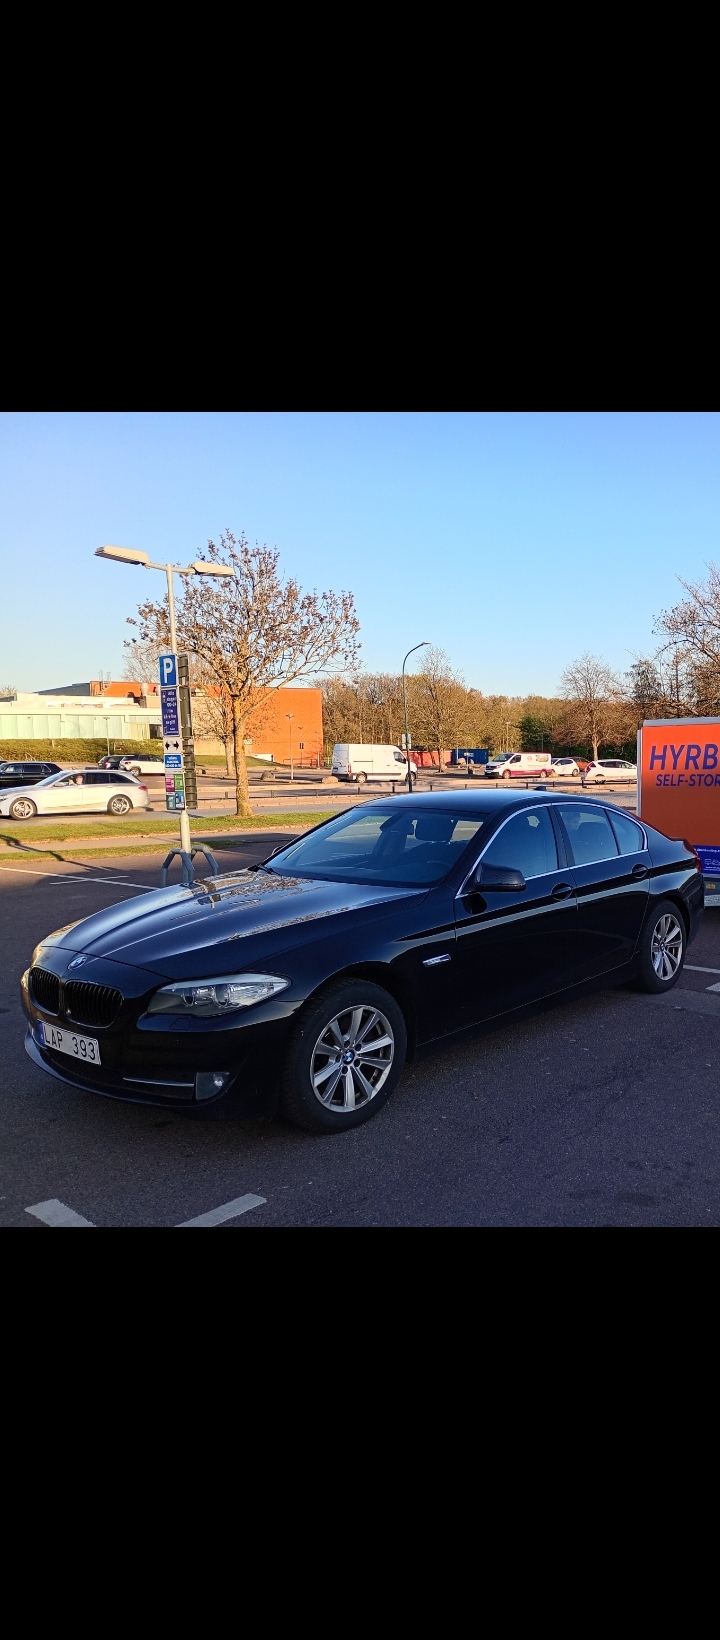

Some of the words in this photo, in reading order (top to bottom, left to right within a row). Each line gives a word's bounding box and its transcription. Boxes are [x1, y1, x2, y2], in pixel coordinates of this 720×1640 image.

[163, 658, 173, 683] P
[649, 744, 719, 770] HYRB
[44, 1025, 63, 1049] LAP
[71, 1036, 96, 1061] 393
